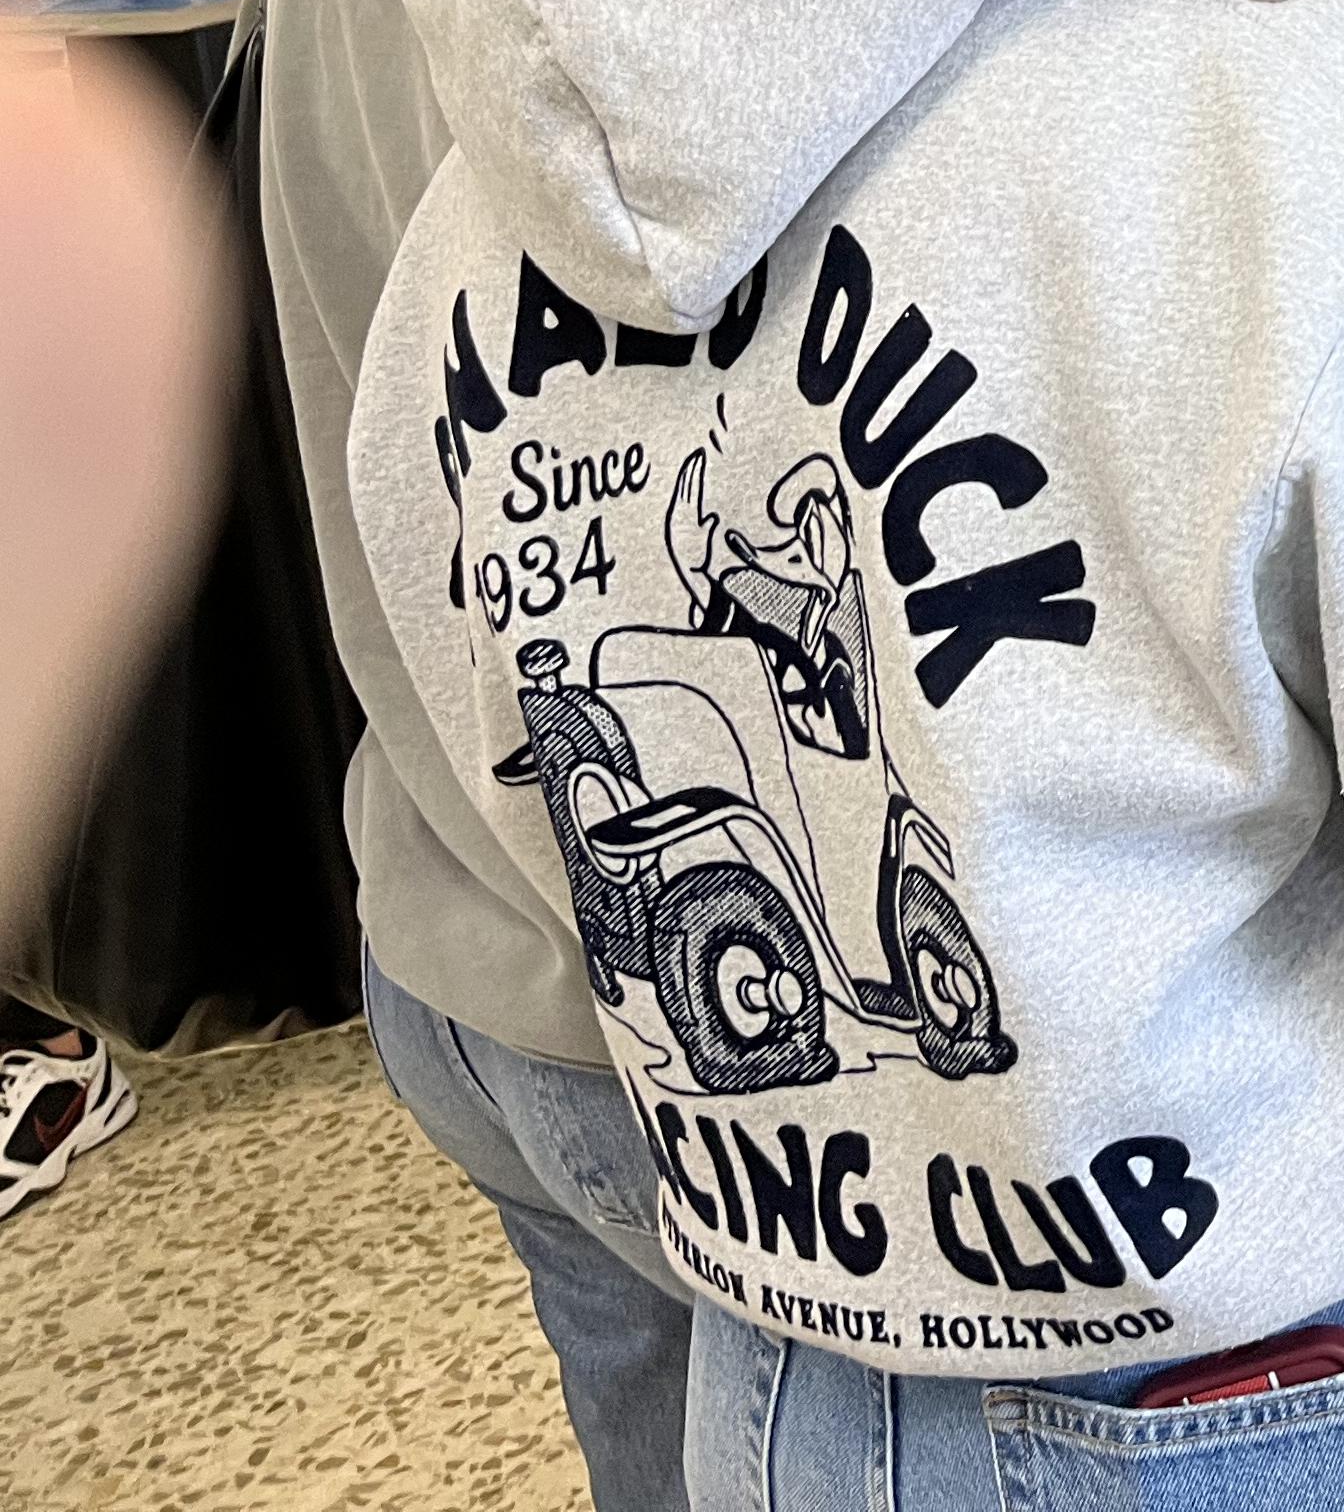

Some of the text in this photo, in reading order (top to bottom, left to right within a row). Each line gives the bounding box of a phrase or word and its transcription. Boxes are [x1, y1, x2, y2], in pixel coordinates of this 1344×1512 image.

[502, 439, 650, 523] Since
[797, 224, 1096, 709] DUCK
[626, 1067, 1220, 1293] CING CLUB
[760, 1284, 901, 1348] AVENUE,
[919, 1307, 1174, 1349] HOLLYWOOD
